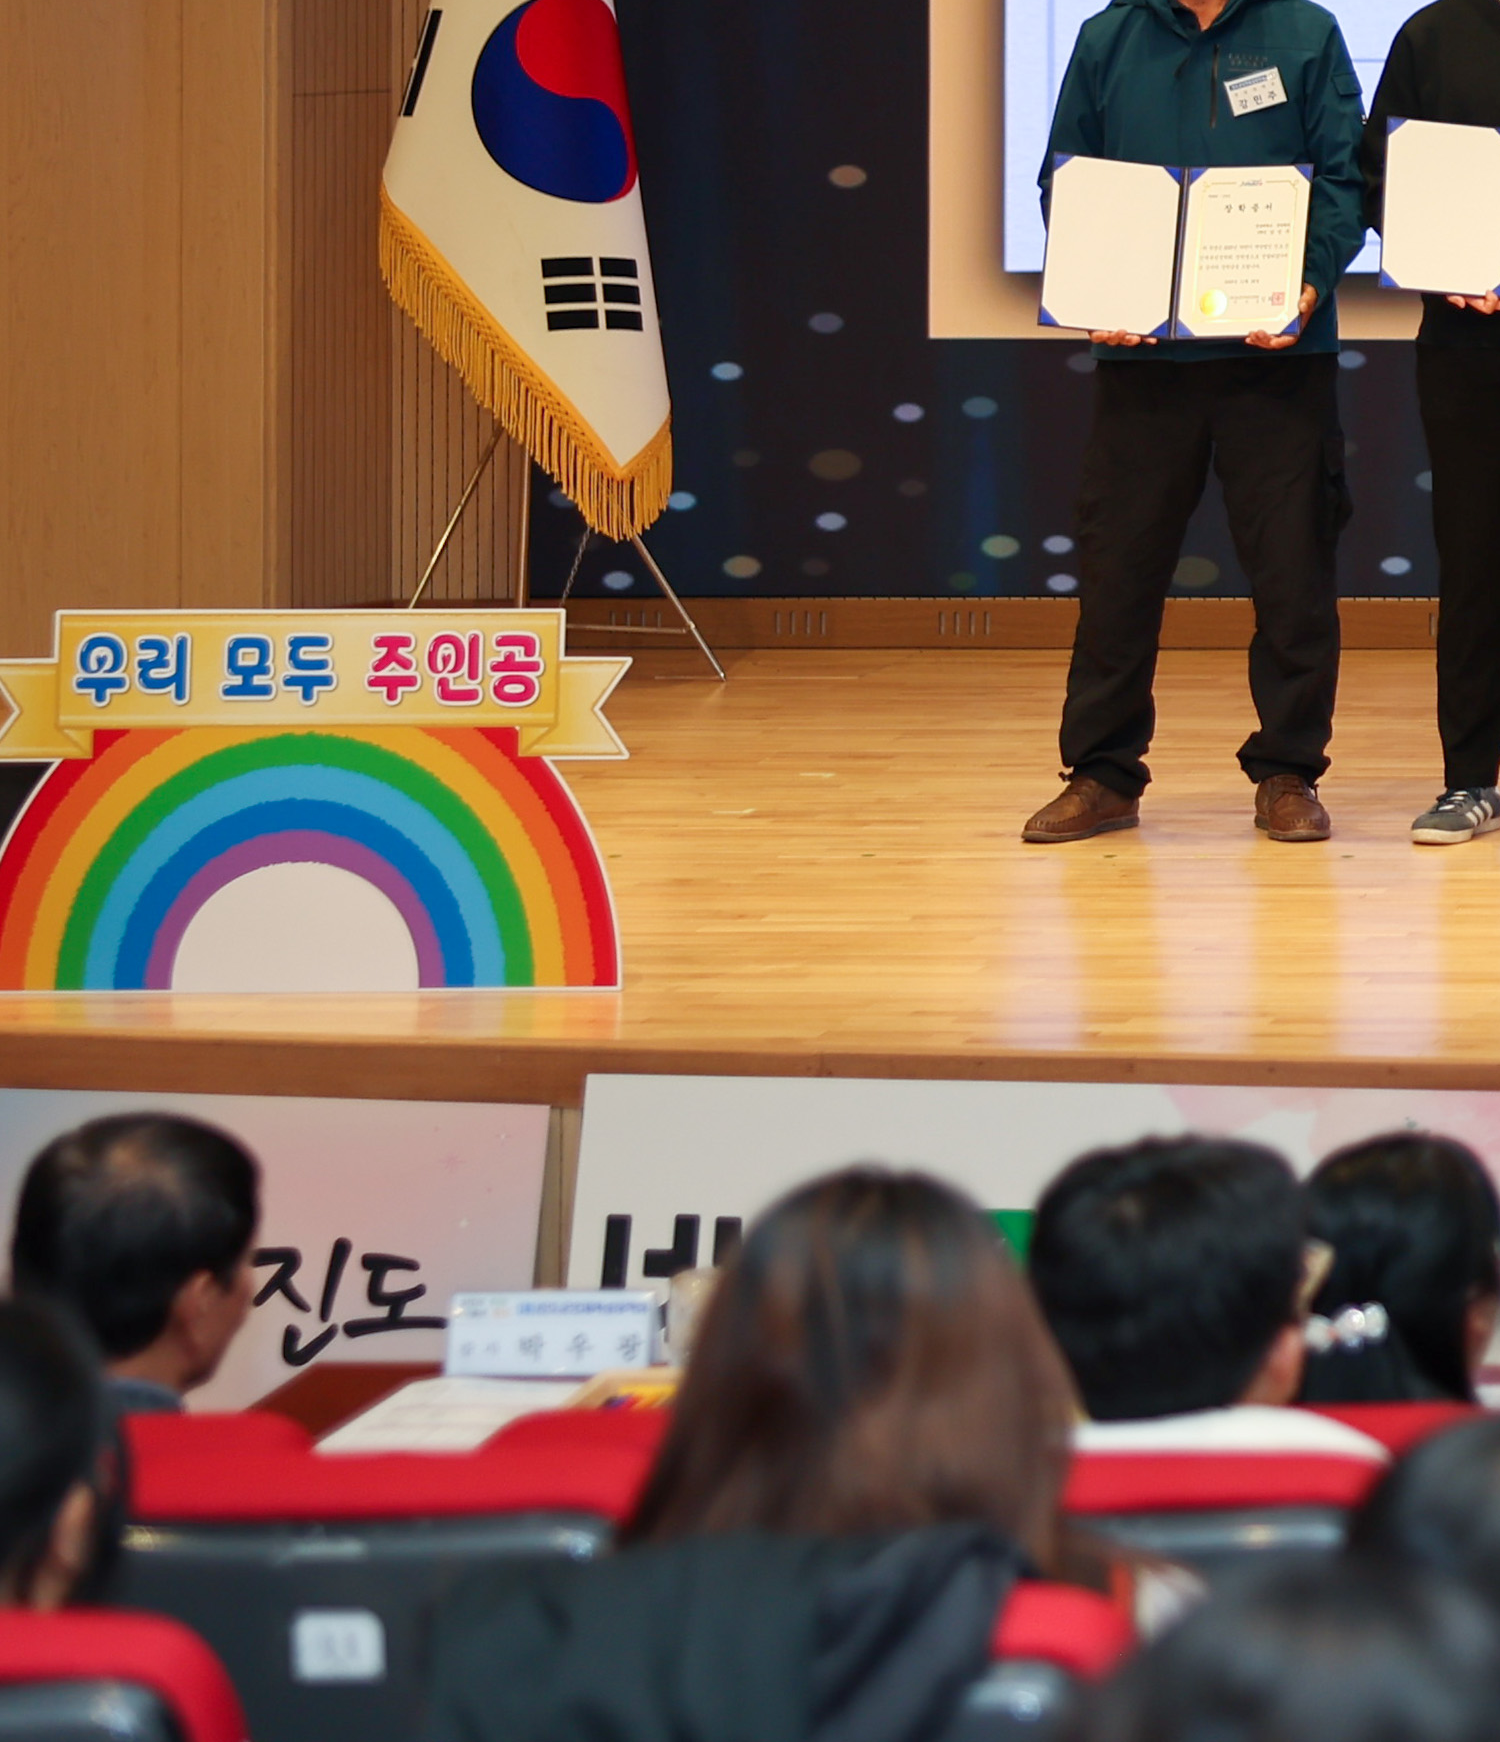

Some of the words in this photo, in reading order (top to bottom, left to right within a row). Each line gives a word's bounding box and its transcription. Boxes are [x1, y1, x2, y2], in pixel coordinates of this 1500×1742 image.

[74, 633, 190, 706] 우리
[221, 633, 335, 706] 모두
[366, 632, 543, 706] 주인공
[251, 1236, 449, 1367] 진도
